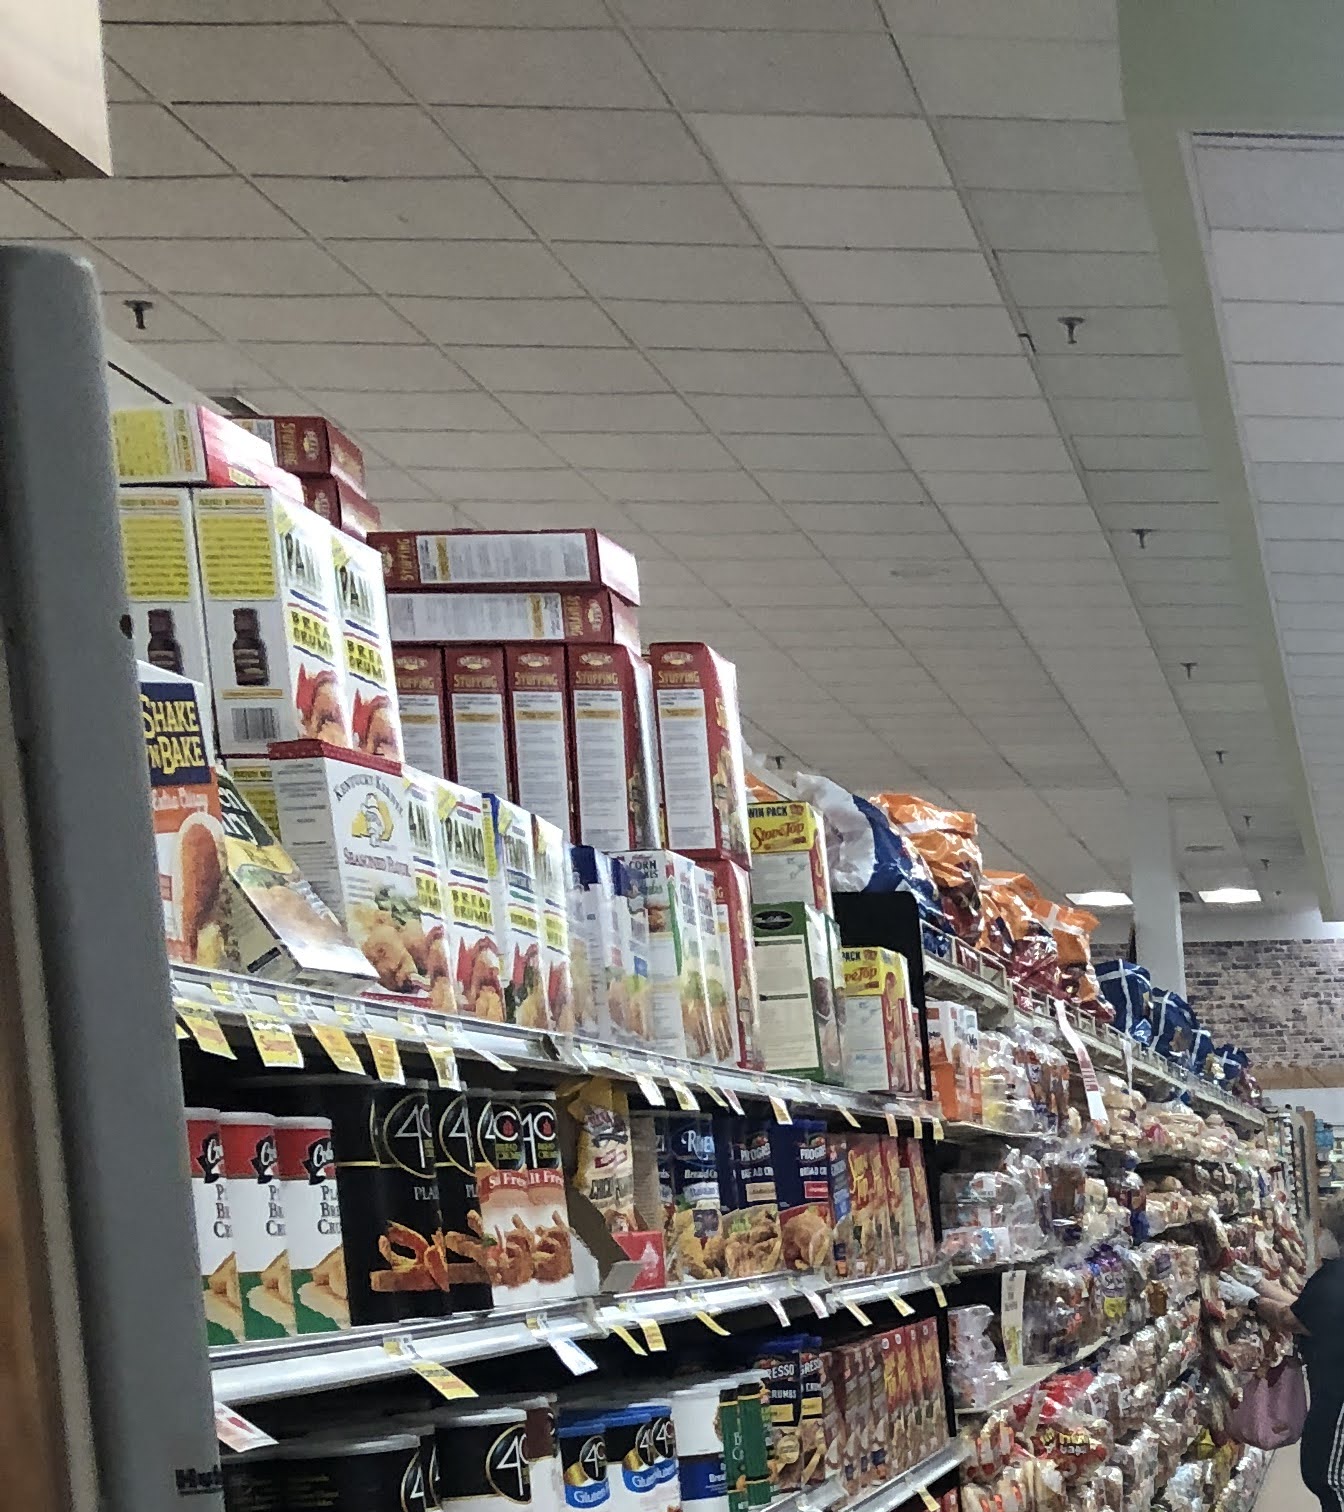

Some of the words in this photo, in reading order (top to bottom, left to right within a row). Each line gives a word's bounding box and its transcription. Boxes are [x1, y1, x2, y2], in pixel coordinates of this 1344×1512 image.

[396, 675, 436, 690] TUFFING
[139, 692, 199, 739] SHAKE
[159, 736, 205, 775] BAKE
[747, 806, 765, 818] WIN
[766, 806, 788, 817] PACK
[783, 822, 805, 838] Top
[628, 859, 657, 870] CORN
[448, 1106, 474, 1168] 4
[413, 1186, 440, 1200] PLA
